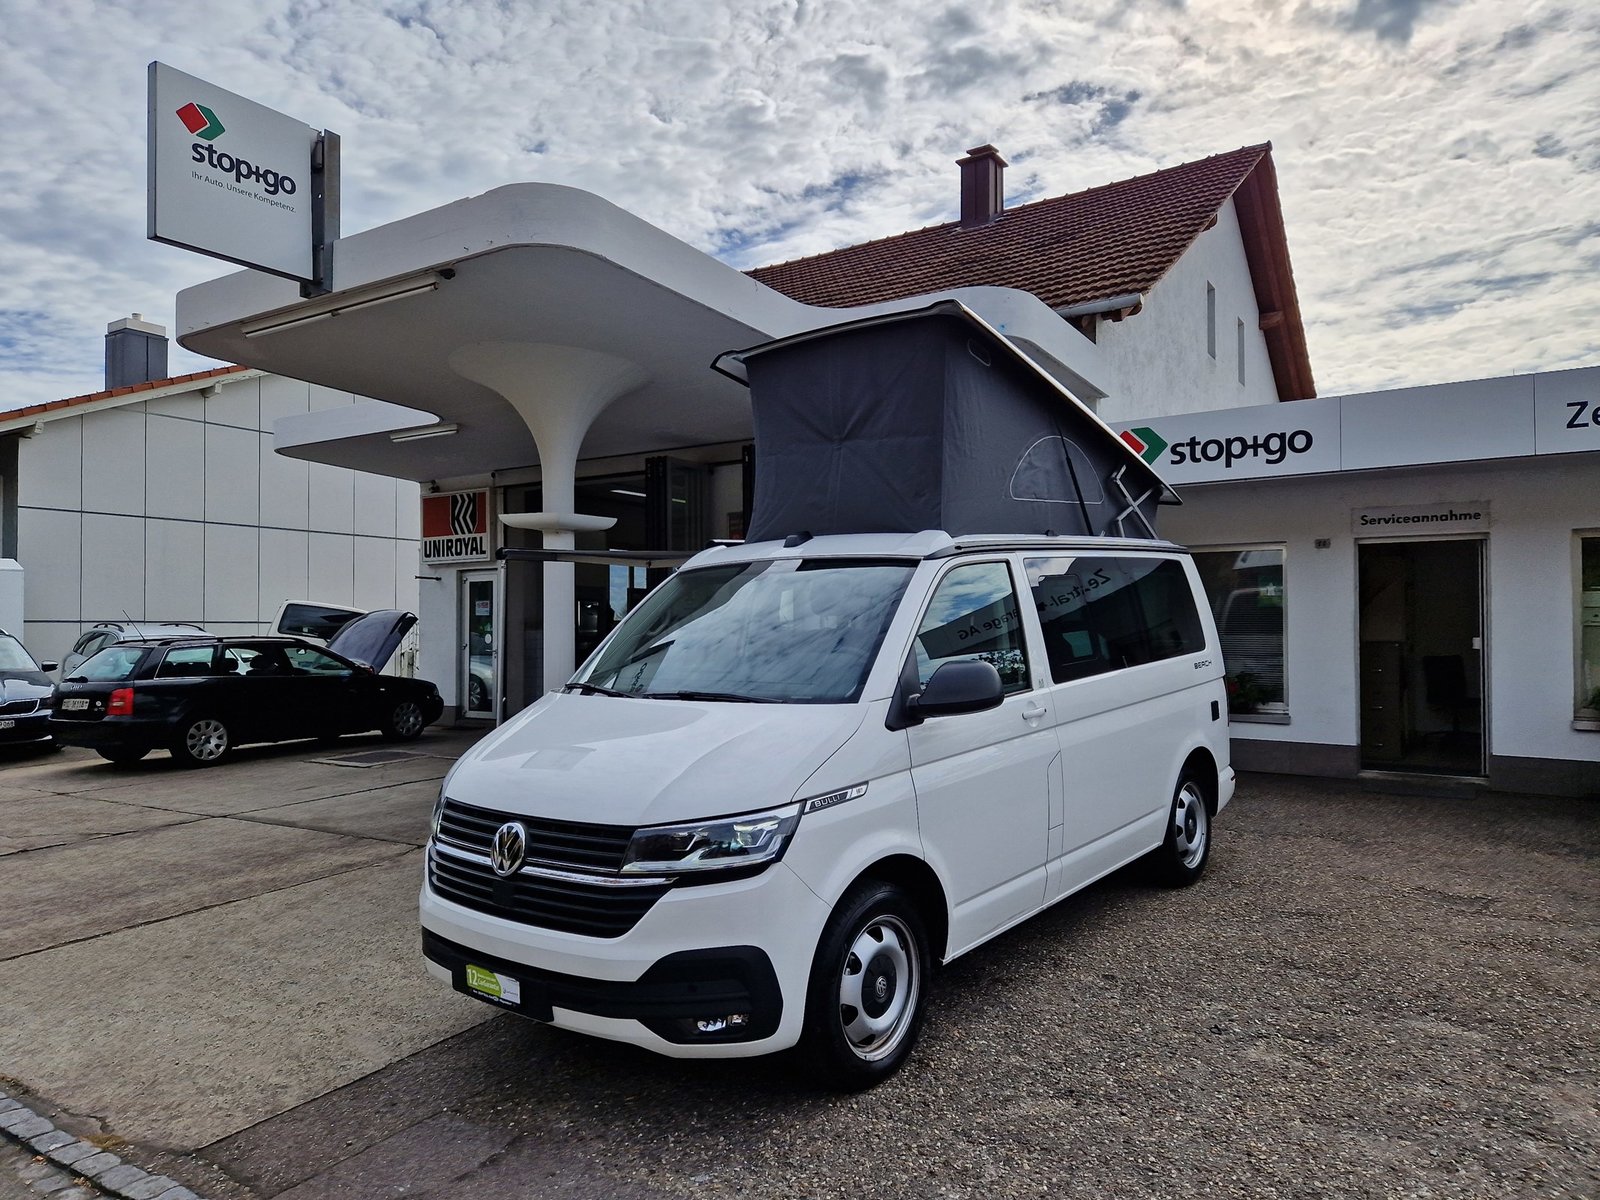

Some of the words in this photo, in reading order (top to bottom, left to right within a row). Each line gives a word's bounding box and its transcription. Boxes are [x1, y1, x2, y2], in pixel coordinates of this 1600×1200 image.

[192, 143, 296, 195] stop+go
[191, 171, 203, 181] Ihr
[204, 175, 225, 189] Auto.
[226, 184, 253, 198] Unsere
[254, 193, 296, 213] Kompetenz.
[1169, 429, 1314, 469] stop+go
[1360, 510, 1482, 526] Serviceannahme
[423, 536, 487, 559] UNIROYAL
